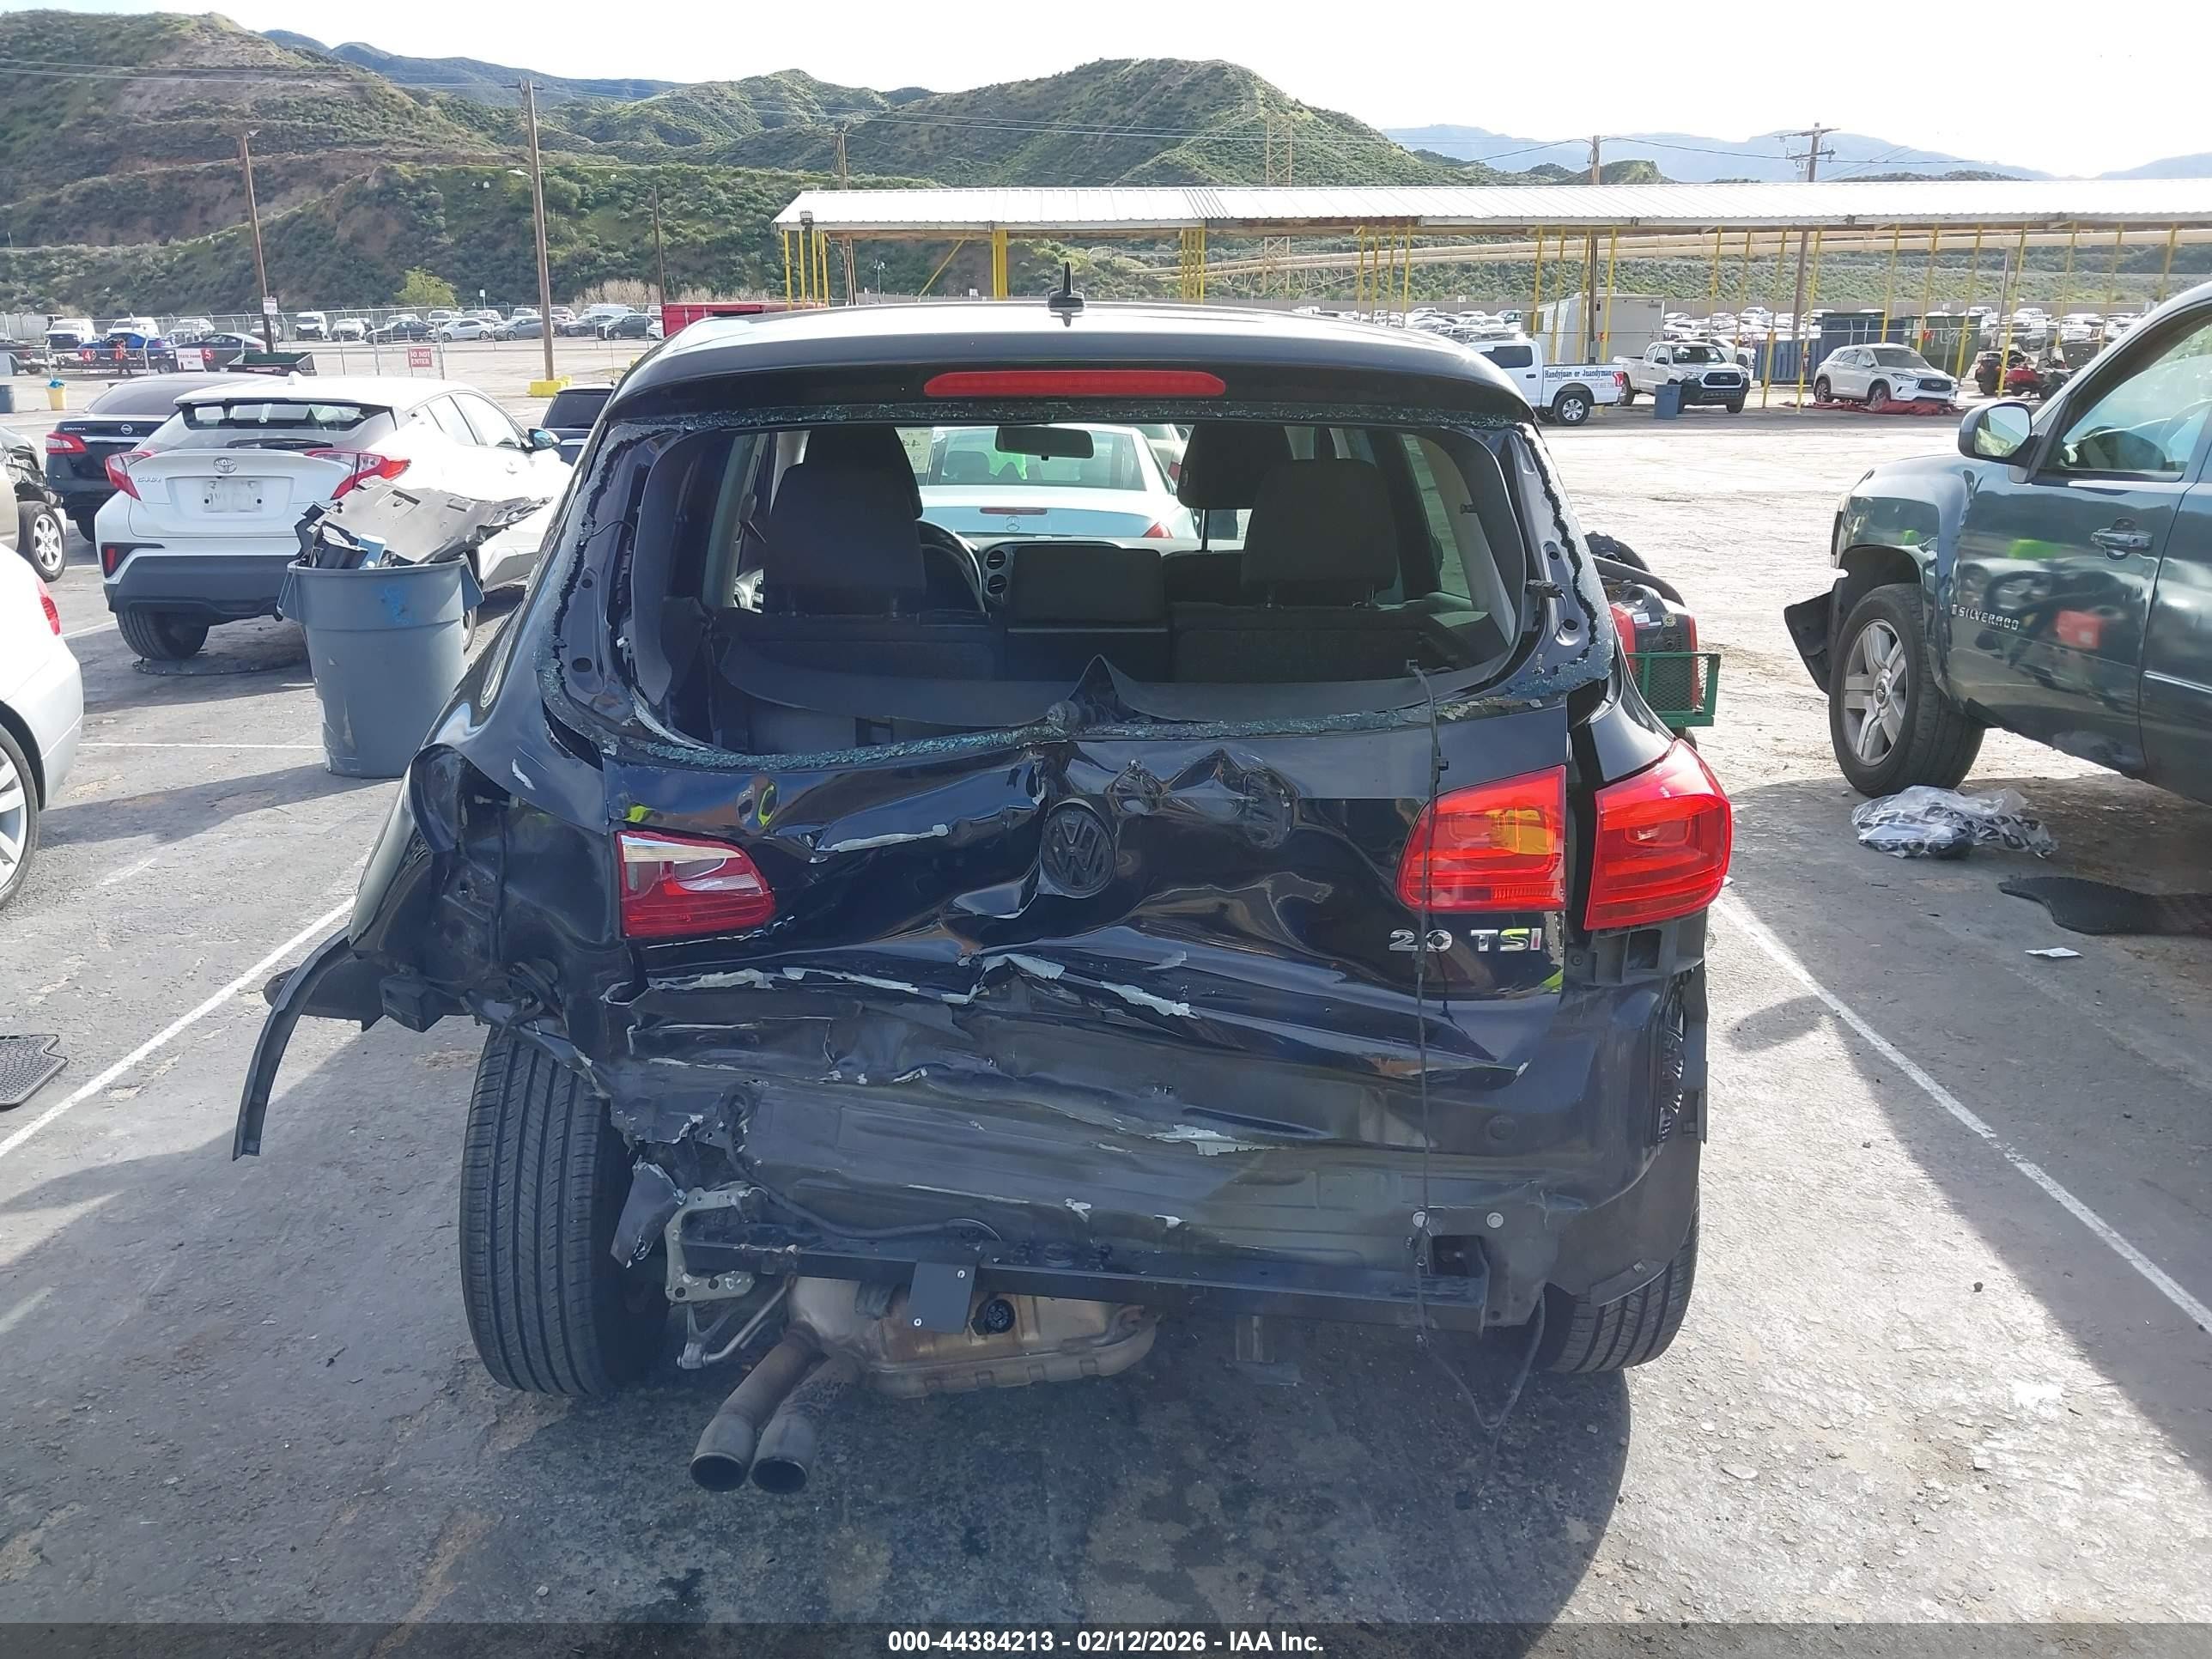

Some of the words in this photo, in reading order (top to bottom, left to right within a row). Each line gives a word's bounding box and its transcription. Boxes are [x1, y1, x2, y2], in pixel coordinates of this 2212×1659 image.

[1545, 369, 1572, 380] Handyjuan
[1582, 369, 1612, 378] Juandyman
[1959, 606, 2019, 630] SILVERADO
[1470, 927, 1542, 951] TSI
